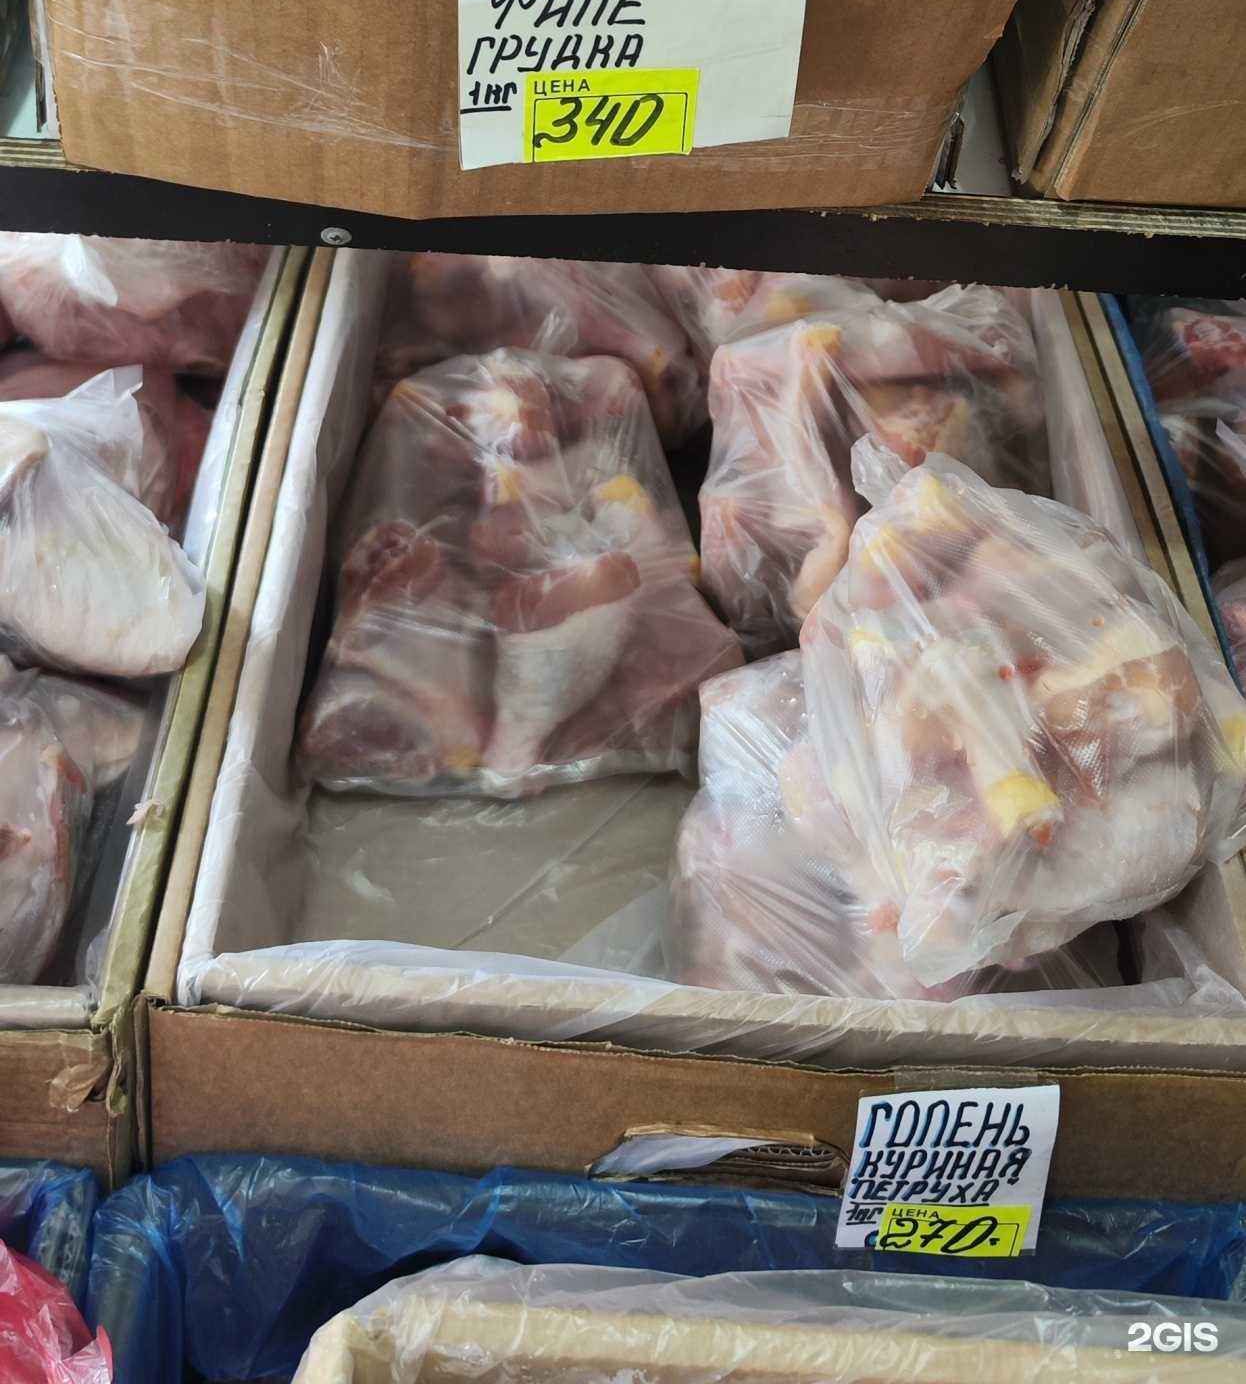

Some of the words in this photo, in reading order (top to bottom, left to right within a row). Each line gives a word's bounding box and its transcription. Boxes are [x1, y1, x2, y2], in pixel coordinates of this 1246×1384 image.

[466, 33, 645, 76] ГРУДКА
[533, 77, 591, 97] ЦЕНА
[533, 94, 665, 149] 340
[852, 1147, 1033, 1180] КУРИНАЯ
[891, 1207, 940, 1219] ЦЕНА
